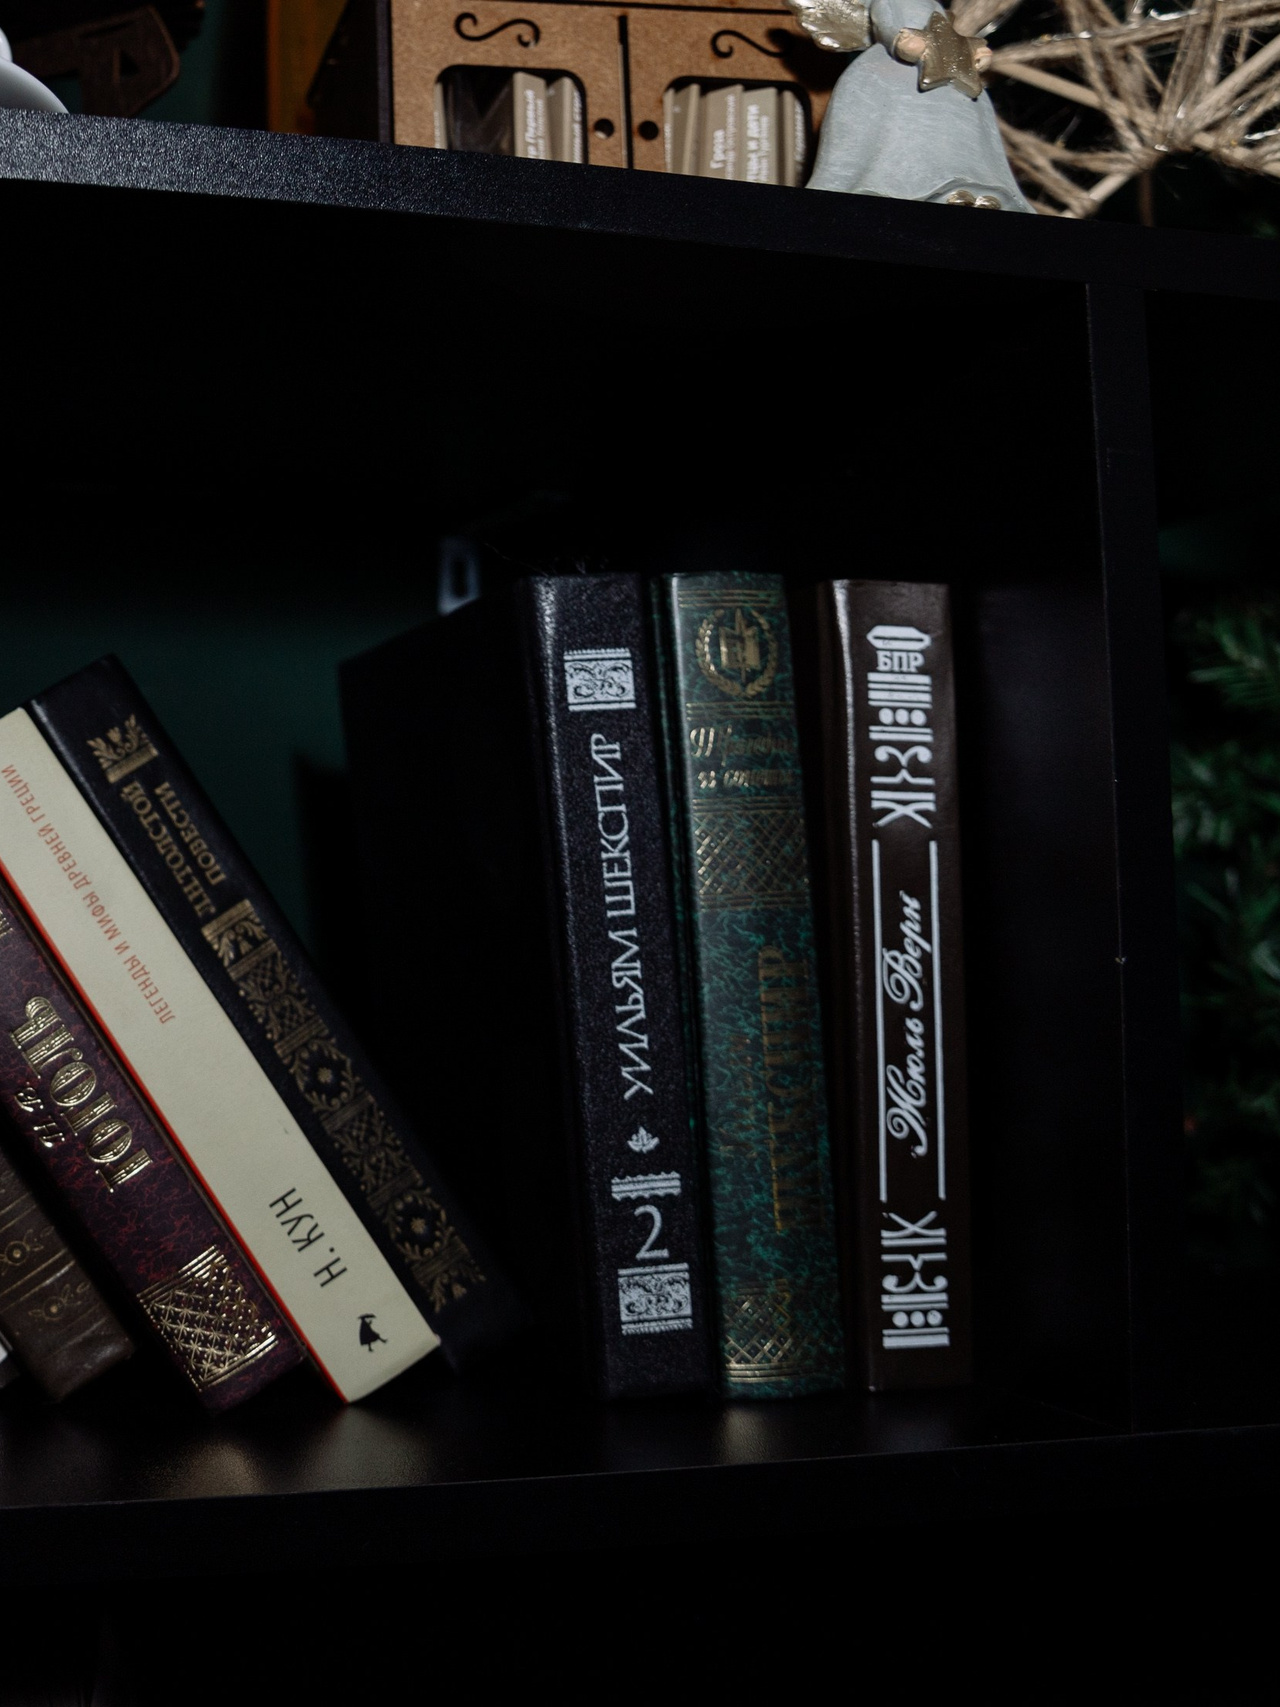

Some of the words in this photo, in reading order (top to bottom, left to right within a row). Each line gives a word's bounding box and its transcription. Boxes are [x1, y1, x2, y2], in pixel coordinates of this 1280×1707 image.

[876, 650, 925, 674] БПР
[1, 764, 45, 823] ГРЕЦИИ
[590, 731, 637, 922] ШЕКСПИР
[38, 823, 92, 890] ДРЕВНЕЙ
[154, 781, 227, 887] ПОВЕСТИ
[82, 891, 122, 941] МИФЫ
[114, 940, 130, 955] И
[881, 889, 933, 1013] Верн
[124, 955, 176, 1025] ЛЕГЕНДЫ
[607, 928, 655, 1101] УИЛЬЯМ
[9, 996, 154, 1193] ГОГОЛЬ
[886, 1013, 930, 1159] Жюль
[269, 1187, 324, 1252] КУН
[633, 1203, 671, 1261] 2
[313, 1247, 348, 1287] Н.
